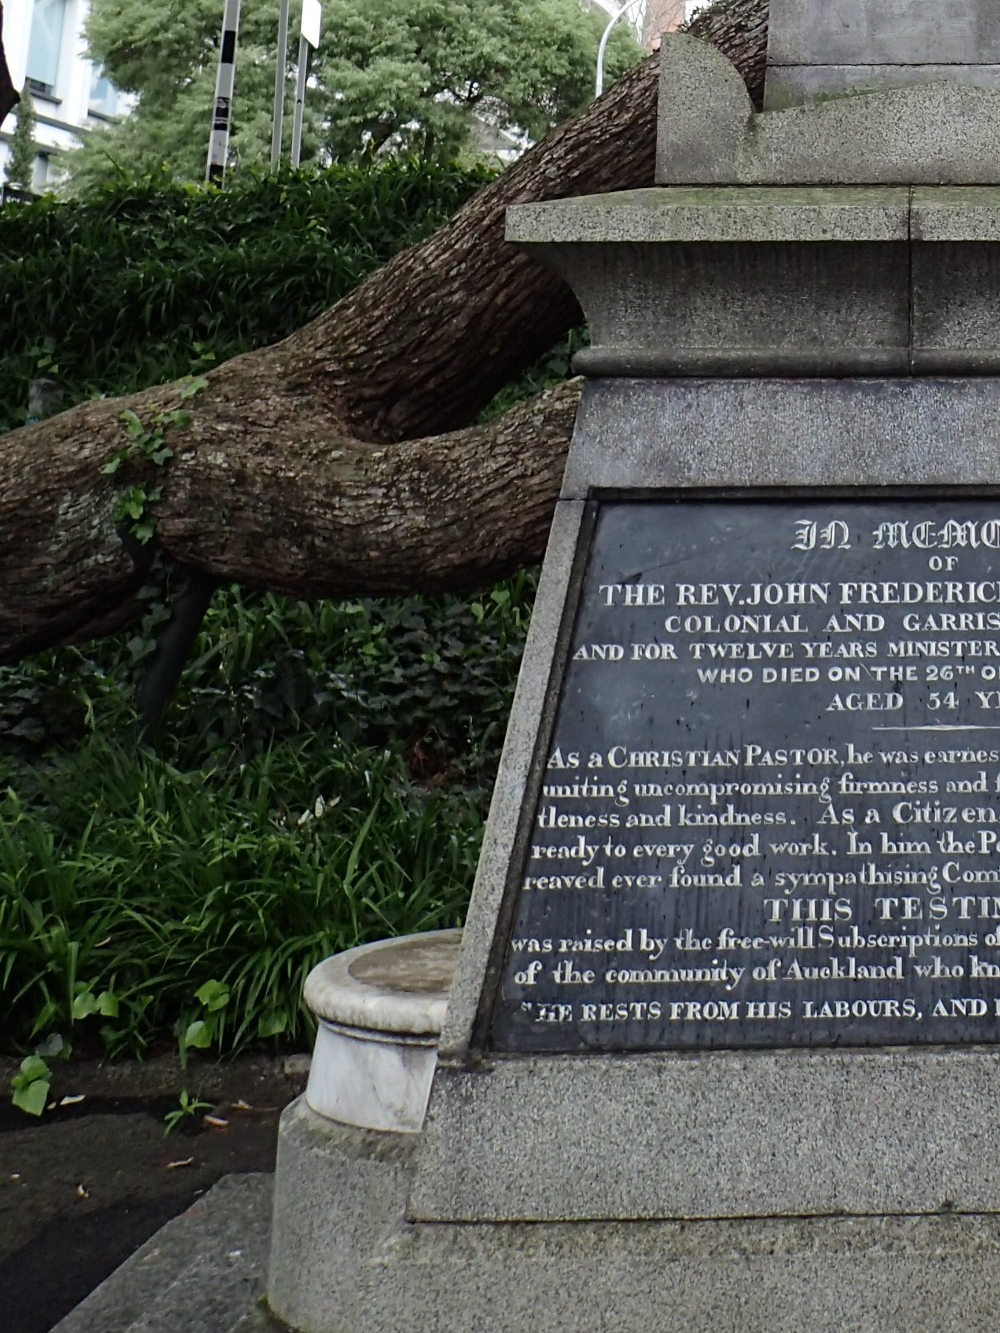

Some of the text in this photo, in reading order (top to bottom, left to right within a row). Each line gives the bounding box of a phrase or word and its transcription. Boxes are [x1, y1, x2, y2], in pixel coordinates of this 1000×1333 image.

[791, 520, 851, 550] IN
[929, 556, 959, 571] OF
[600, 583, 665, 606] THE
[665, 615, 808, 634] COLONIAL
[823, 615, 885, 633] AND
[572, 644, 624, 661] AND
[630, 643, 678, 660] FOR
[689, 642, 794, 659] TWELVE
[801, 642, 877, 658] YEARS
[887, 640, 1000, 658] MINISTER
[697, 668, 753, 684] WHO
[762, 667, 820, 683] DIED
[828, 667, 860, 681] ON
[871, 666, 918, 681] THE
[826, 693, 903, 712] AGED
[926, 691, 959, 710] 54
[547, 746, 580, 769] As
[608, 746, 740, 768] CHRISTIAN
[744, 744, 845, 767] PASTOR,
[848, 743, 873, 765] he
[878, 751, 919, 765] was
[543, 775, 630, 807] uniting
[633, 774, 832, 805] uncompromising
[839, 773, 939, 795] firmness
[946, 771, 988, 793] and
[537, 805, 621, 828] tleness
[625, 804, 671, 827] and
[677, 804, 797, 826] kindness.
[816, 803, 854, 825] As
[531, 835, 600, 866] ready
[632, 842, 695, 865] every
[701, 833, 762, 866] good
[768, 832, 838, 856] work.
[880, 831, 931, 854] him
[522, 867, 605, 890] reaved
[611, 874, 662, 889] ever
[669, 865, 743, 888] found
[774, 861, 942, 895] sympathising
[763, 898, 852, 921] THIS
[510, 937, 553, 953] was
[558, 929, 633, 953] raised
[639, 928, 669, 960] by
[674, 928, 712, 951] the
[717, 926, 816, 952] free-will
[817, 923, 978, 958] Subscriptions
[514, 960, 542, 985] of
[551, 960, 596, 984] the
[605, 958, 746, 991] community
[752, 958, 782, 981] of
[781, 956, 905, 980] Auckland
[913, 956, 964, 978] who
[580, 1002, 662, 1022] RESTS
[669, 1001, 740, 1020] FROM
[746, 1001, 792, 1019] HIS
[802, 999, 923, 1020] LABOURS,
[931, 998, 988, 1016] AND
